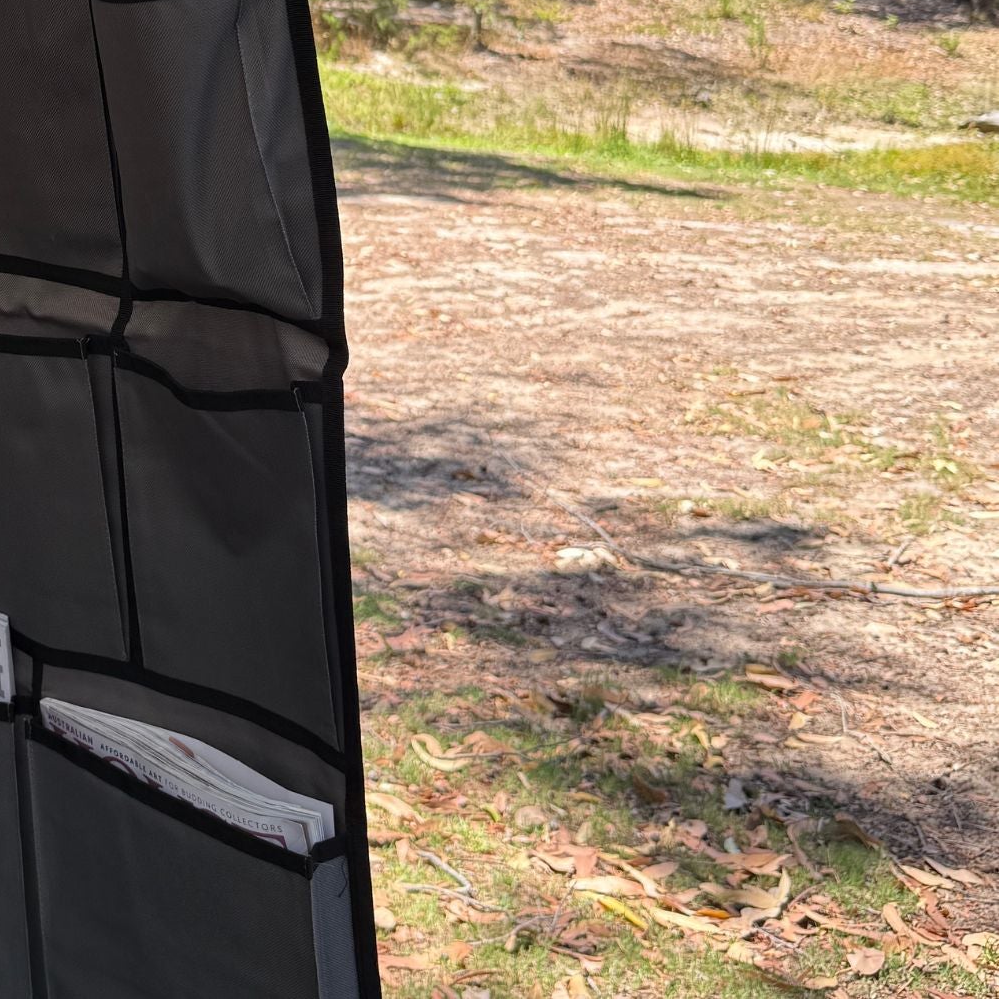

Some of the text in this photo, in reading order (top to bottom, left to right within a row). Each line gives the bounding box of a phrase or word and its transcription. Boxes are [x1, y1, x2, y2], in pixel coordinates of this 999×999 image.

[47, 712, 93, 746] AUSTRALIAN
[100, 743, 147, 774] AFFORDABLE
[181, 787, 217, 812] BUDDING
[220, 808, 284, 833] COLLECTORS
